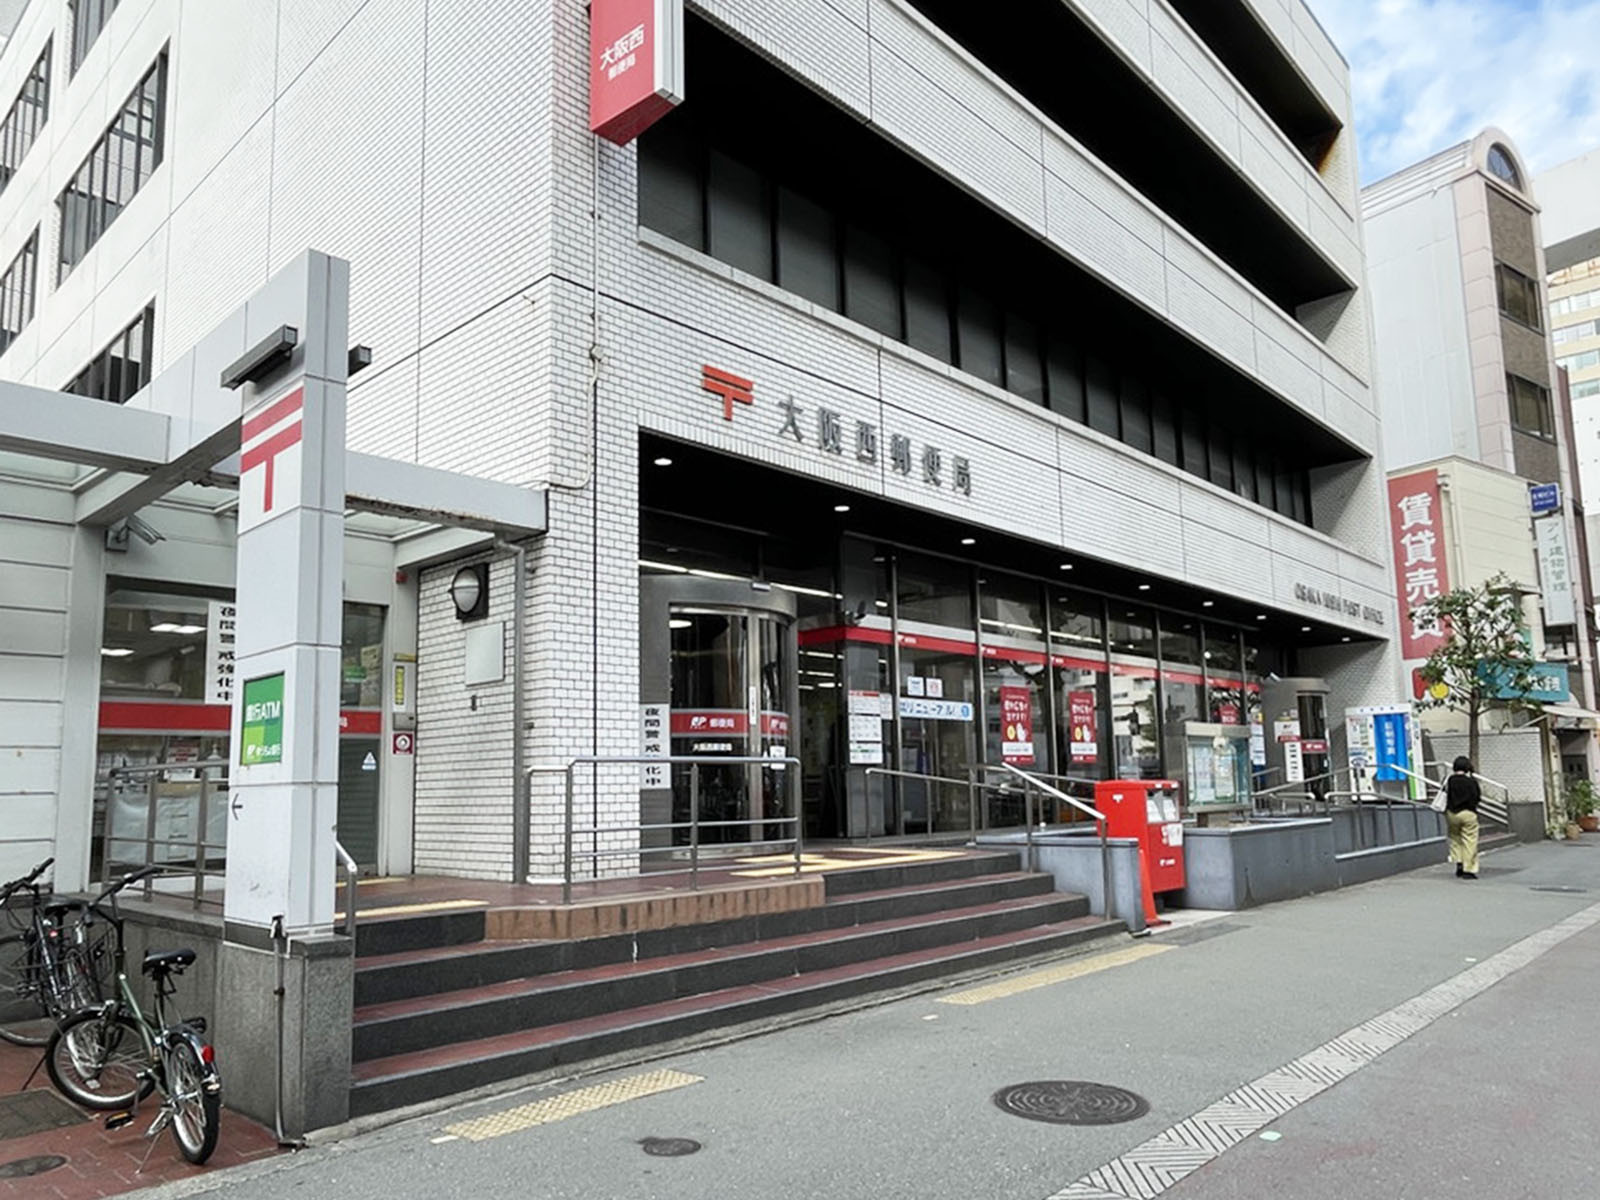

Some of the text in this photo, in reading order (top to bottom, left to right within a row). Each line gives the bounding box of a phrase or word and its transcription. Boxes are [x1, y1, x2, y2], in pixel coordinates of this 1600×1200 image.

[600, 23, 645, 71] 大阪西
[777, 395, 972, 497] 大阪西郵便局
[644, 707, 662, 786] 夜間警戒化中
